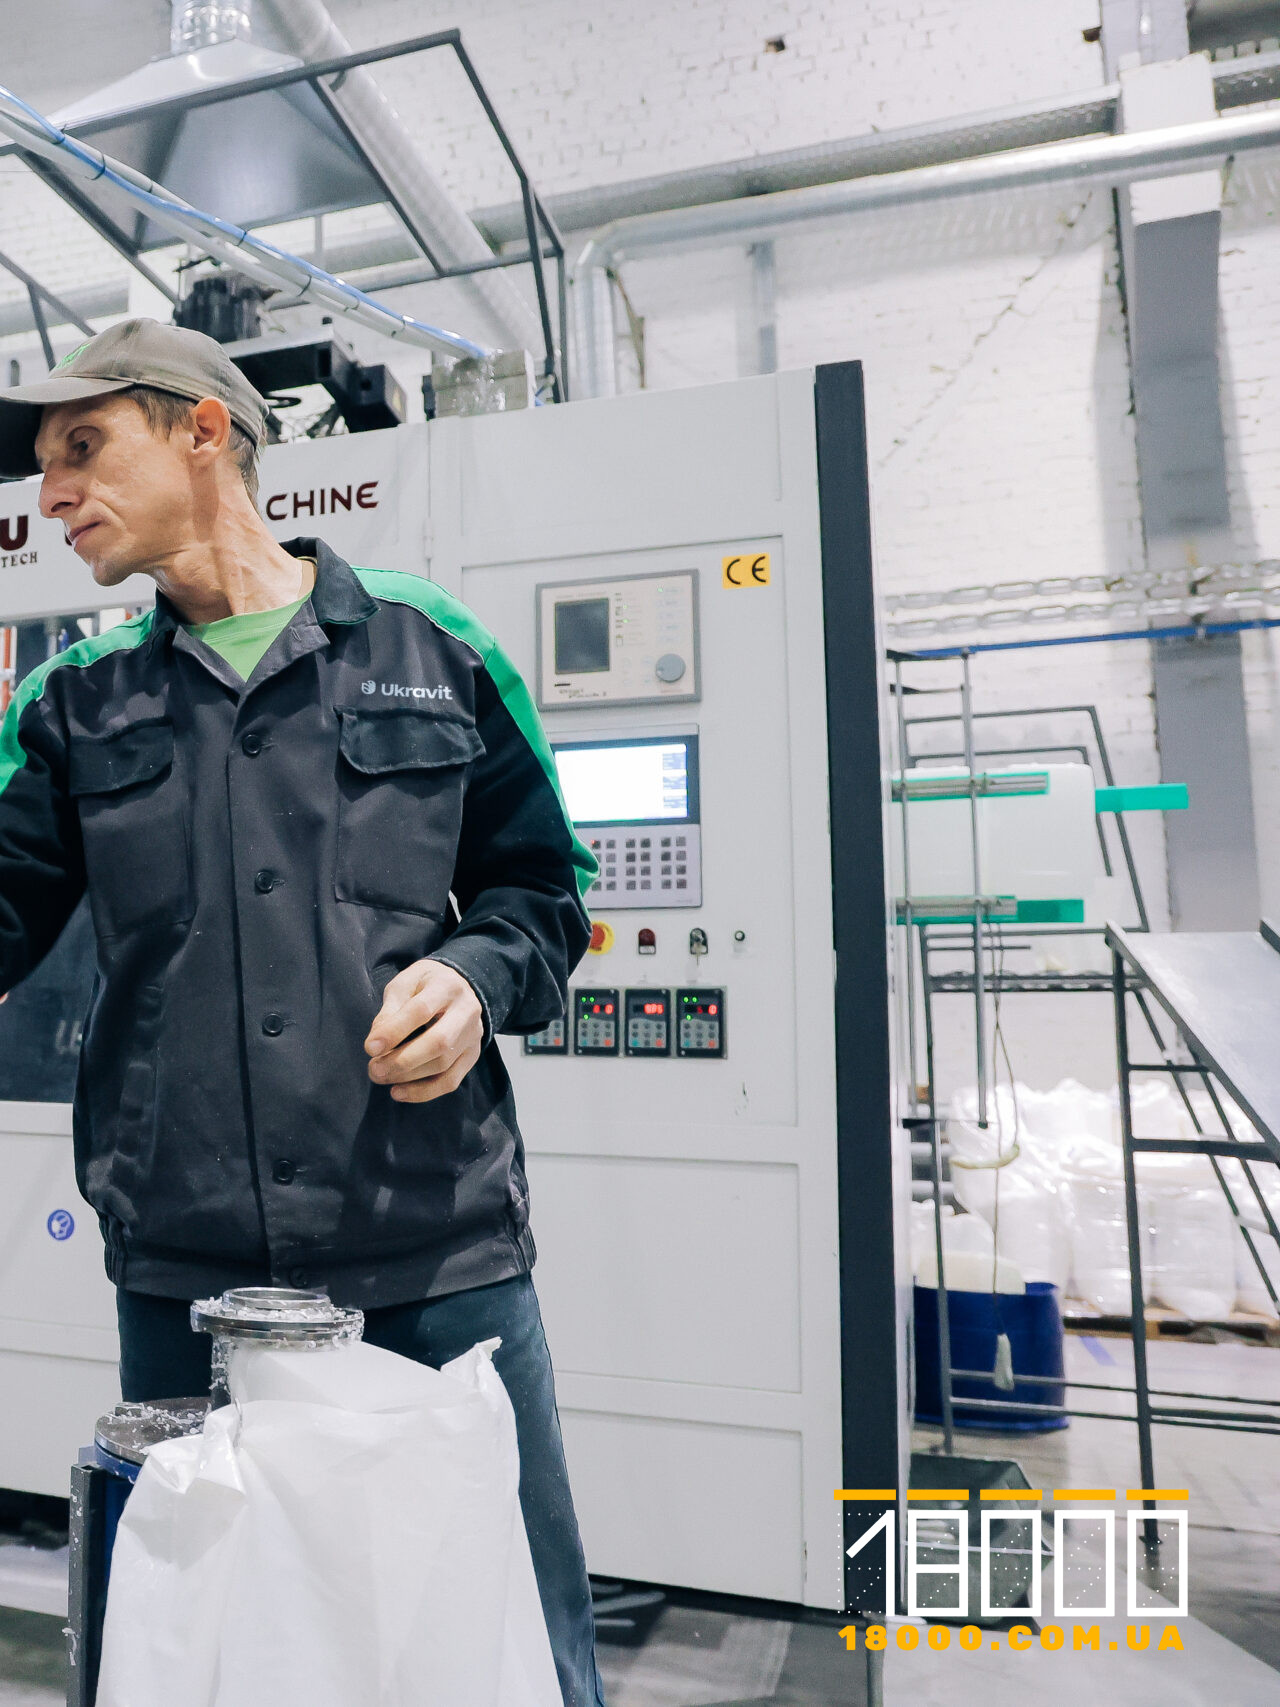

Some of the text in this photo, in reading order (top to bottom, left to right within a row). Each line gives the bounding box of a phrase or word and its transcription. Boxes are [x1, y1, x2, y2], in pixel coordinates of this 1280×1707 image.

[266, 481, 379, 520] CHINE
[726, 556, 766, 585] CE
[381, 683, 453, 700] Ukravit
